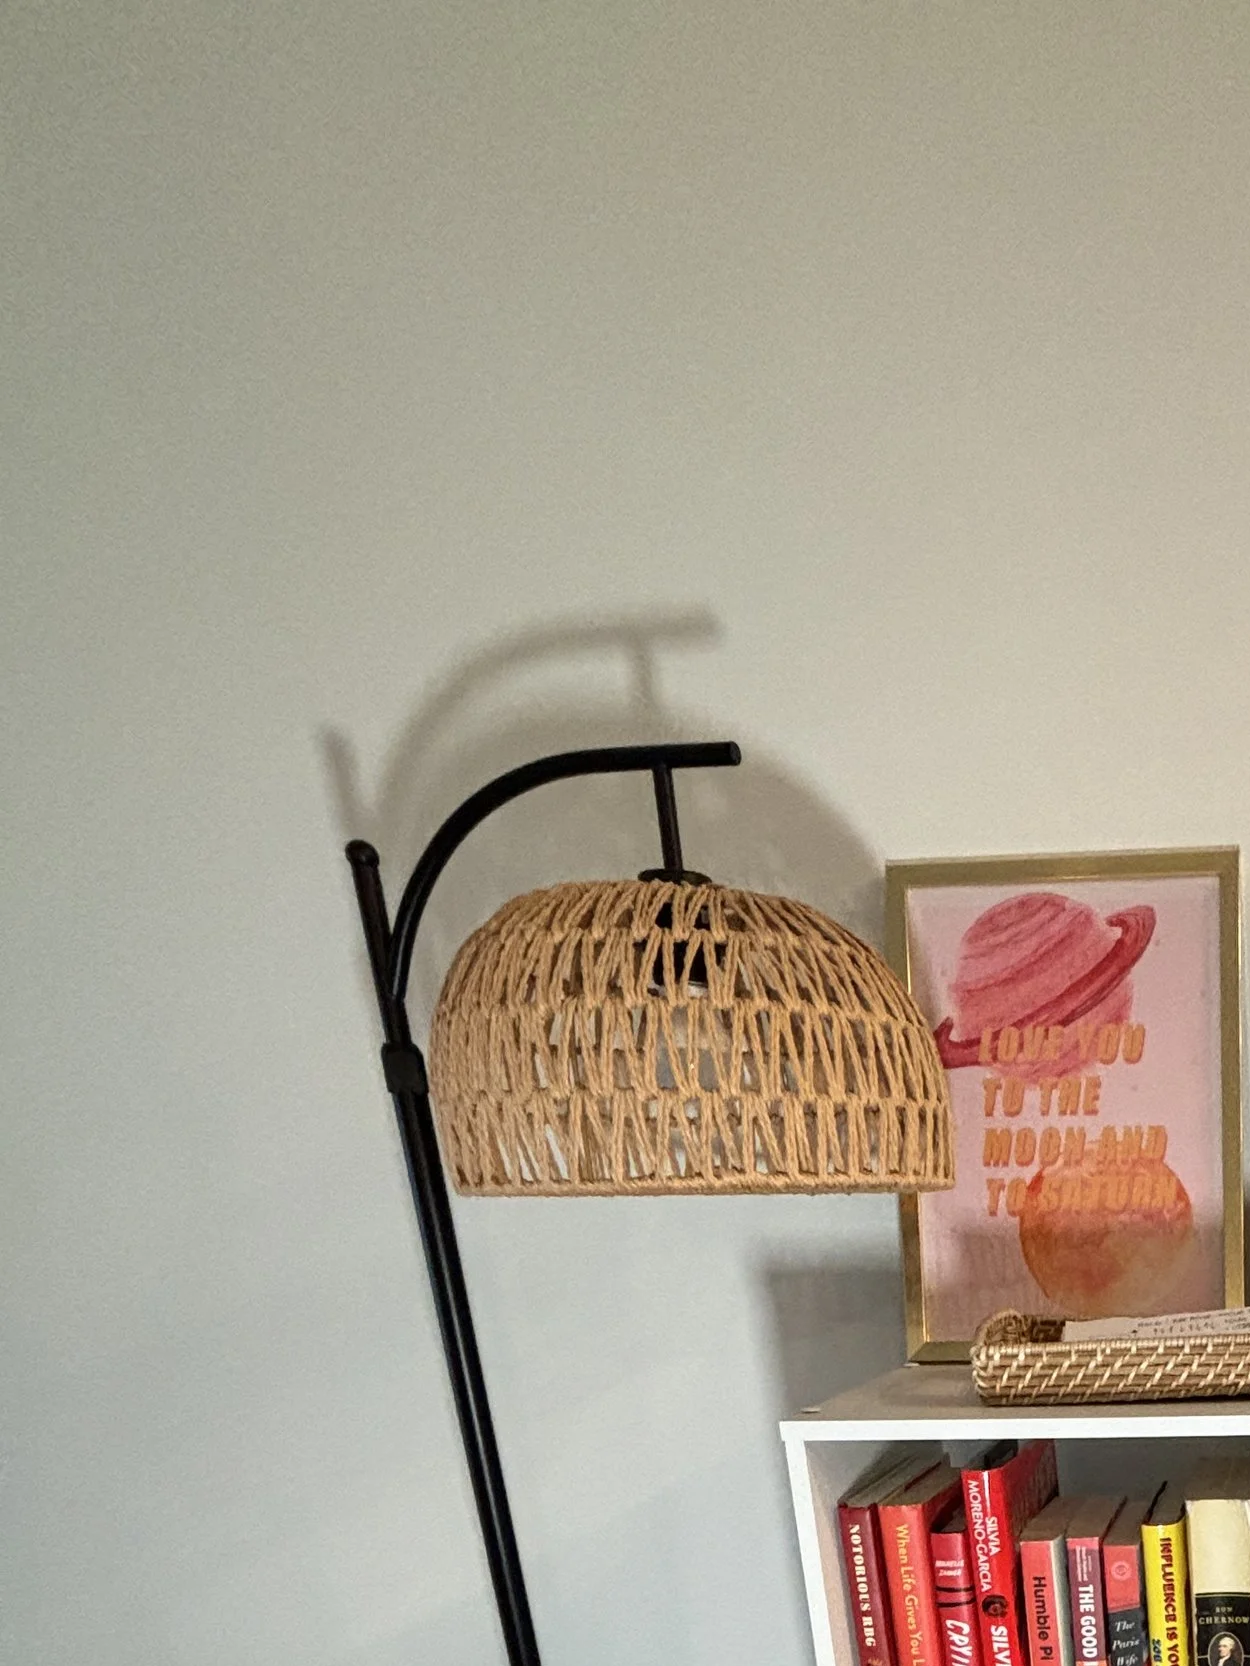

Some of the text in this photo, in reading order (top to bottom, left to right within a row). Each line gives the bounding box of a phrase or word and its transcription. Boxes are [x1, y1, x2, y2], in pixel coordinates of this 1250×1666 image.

[1077, 1023, 1145, 1065] YOU
[983, 1076, 1101, 1117] TO THE
[983, 1127, 1086, 1167] MOON
[986, 1177, 1027, 1217] TO
[896, 1524, 909, 1563] When
[967, 1479, 994, 1593] MORENO-GARCIA
[985, 1515, 1000, 1556] SILVIA
[849, 1523, 877, 1648] NOTORIOUS RBG
[900, 1566, 912, 1592] Life
[1078, 1584, 1094, 1612] THE
[1159, 1536, 1178, 1623] INFLUENCE
[906, 1594, 919, 1629] Gives
[1033, 1576, 1053, 1661] Humble Pi
[1199, 1615, 1250, 1625] CHERNOW
[910, 1630, 923, 1655] You
[1080, 1614, 1097, 1657] GOOD
